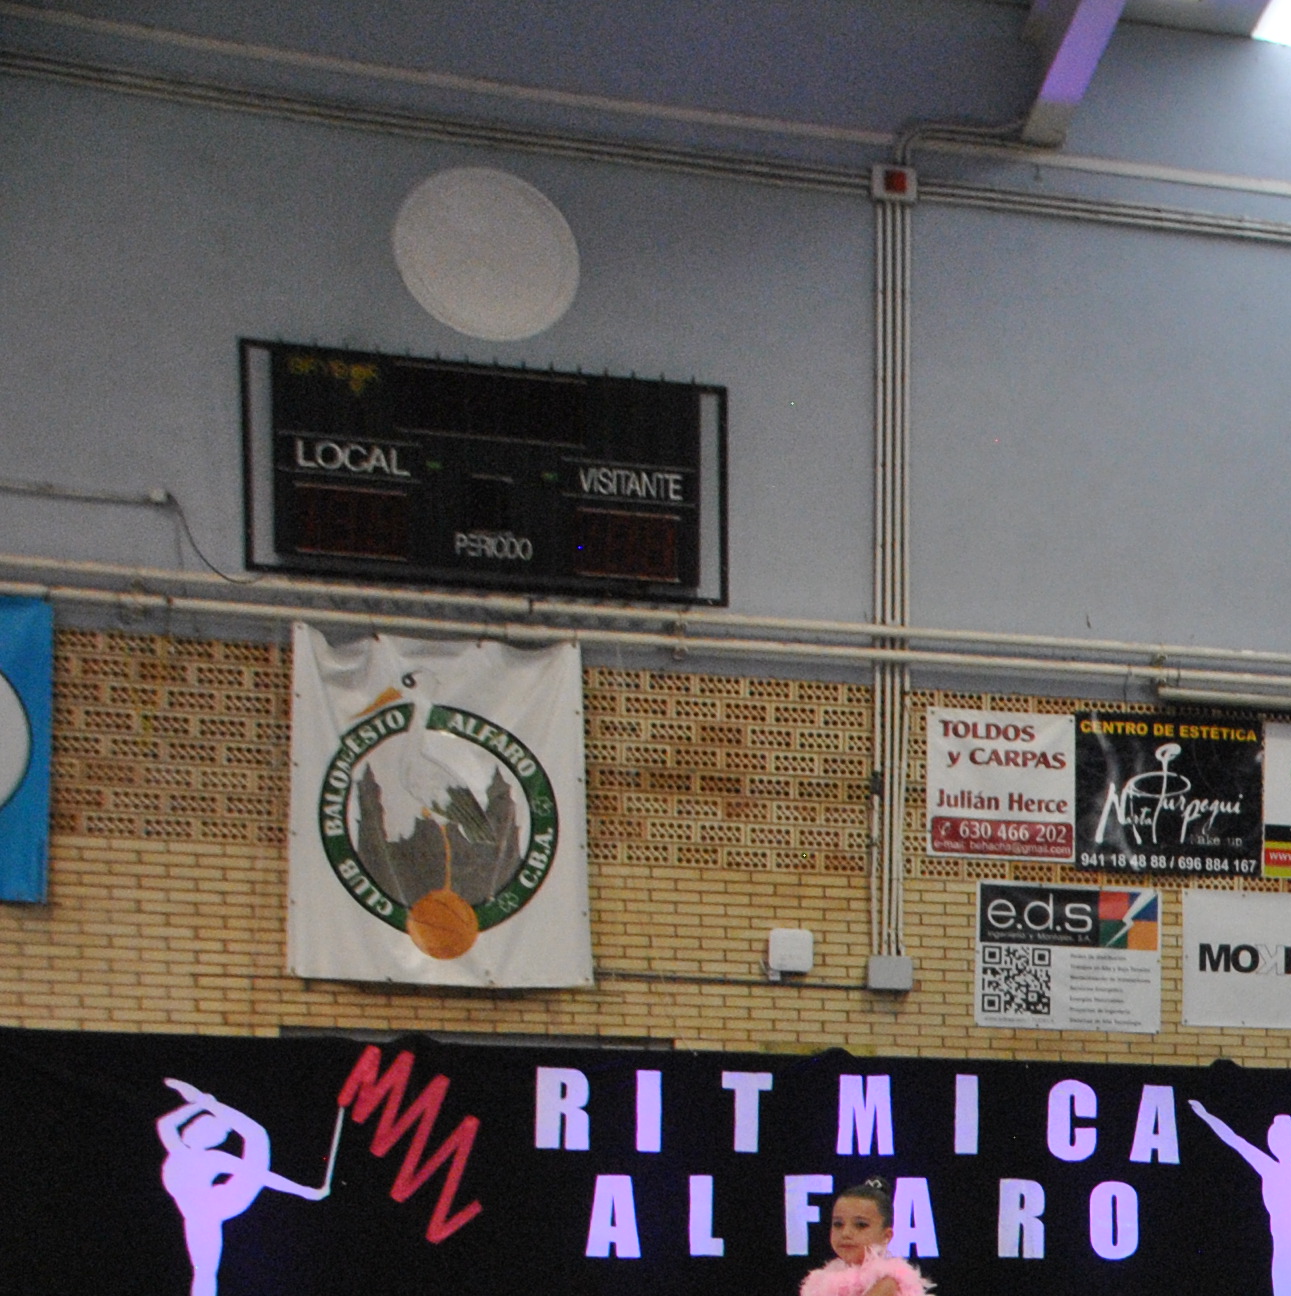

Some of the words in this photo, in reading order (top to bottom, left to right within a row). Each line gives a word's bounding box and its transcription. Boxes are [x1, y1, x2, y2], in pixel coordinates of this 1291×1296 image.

[295, 439, 411, 477] LOCAL
[579, 467, 684, 500] VISITANTE
[939, 719, 1036, 742] TOLDOS
[1080, 720, 1148, 735] CENTRO
[1153, 723, 1174, 737] DE
[947, 751, 961, 768] y
[969, 748, 1067, 770] CARPAS
[937, 788, 1000, 811] Julián
[1008, 792, 1068, 814] Herce
[339, 859, 394, 917] CLUB
[449, 713, 538, 778] ALFARO
[960, 821, 992, 839] 630
[997, 823, 1029, 841] 466
[1036, 825, 1067, 843] 202
[1081, 853, 1104, 867] 941
[1111, 853, 1126, 867] 18
[1130, 854, 1147, 868] 48
[1150, 855, 1166, 868] 88
[1178, 857, 1202, 870] 696
[1205, 858, 1229, 872] 884
[1233, 859, 1256, 873] 167
